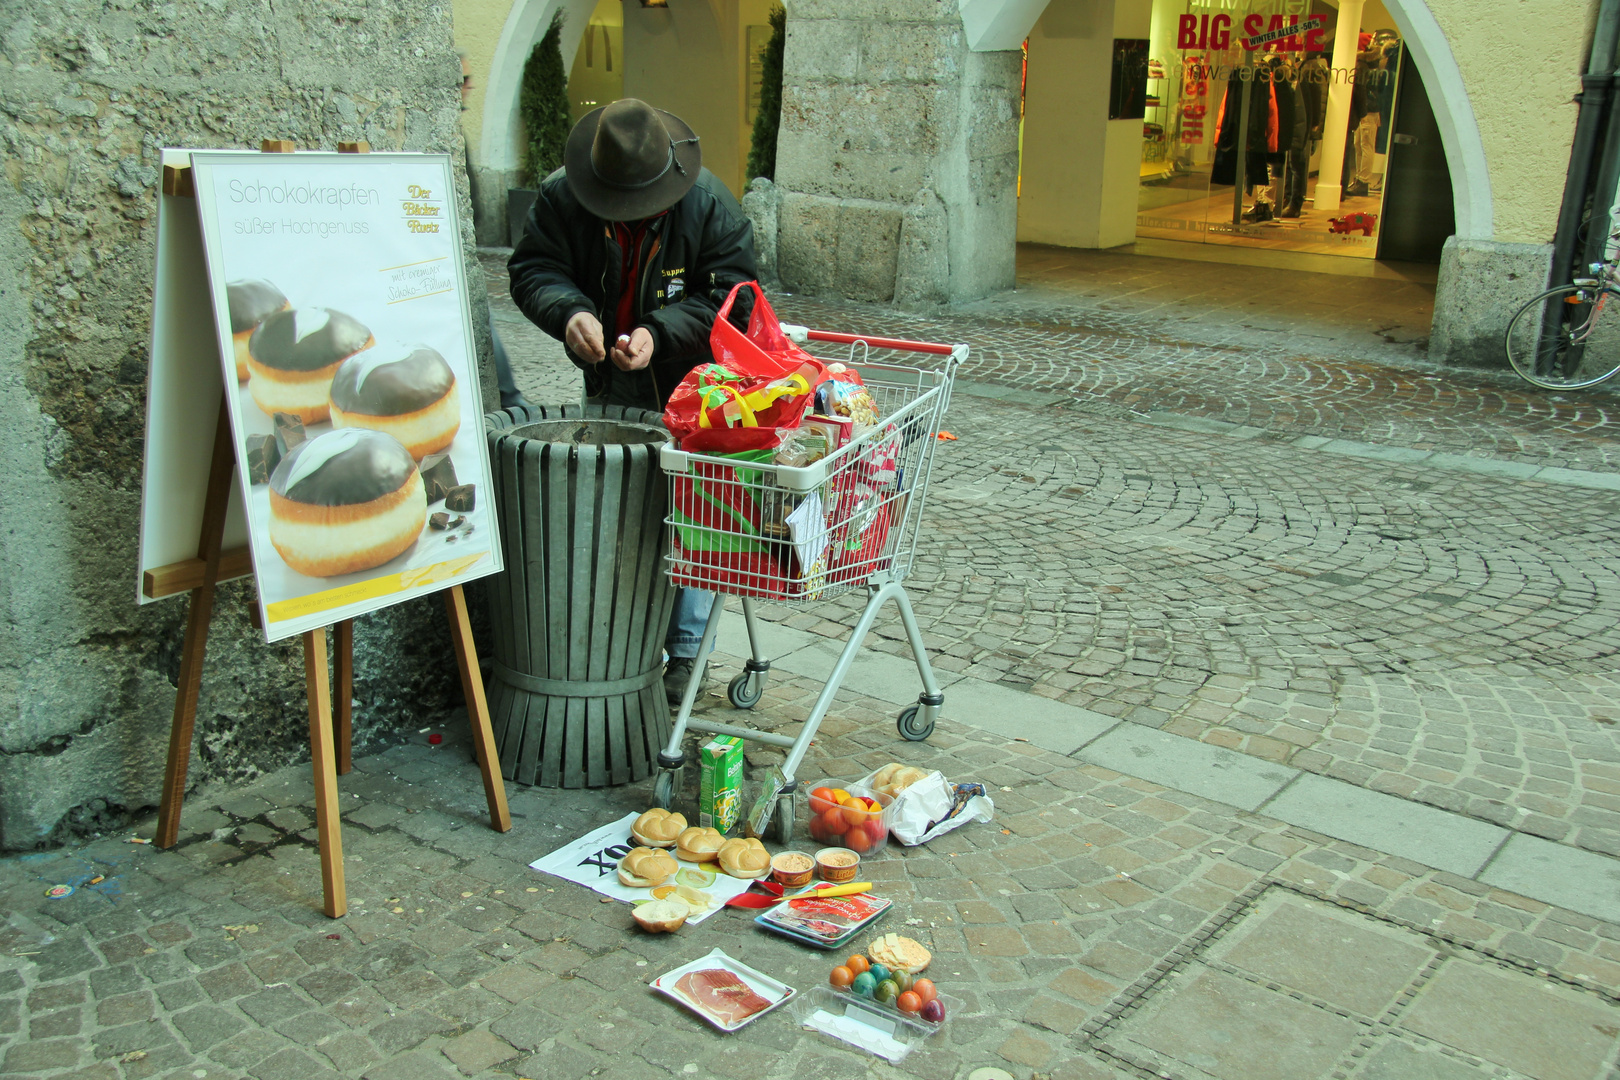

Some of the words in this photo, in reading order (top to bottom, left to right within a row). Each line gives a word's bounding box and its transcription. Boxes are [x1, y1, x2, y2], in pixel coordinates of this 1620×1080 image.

[1177, 13, 1231, 51] BIG
[1242, 14, 1328, 52] SALE
[1249, 31, 1277, 46] WINTER
[1277, 24, 1299, 39] ALLES
[1300, 19, 1320, 32] -50%
[229, 179, 380, 211] Schokokrapfen
[407, 184, 432, 199] Der
[402, 201, 440, 216] Bäcker
[234, 217, 277, 234] süßer
[281, 217, 370, 239] Hochgenuss
[407, 219, 440, 234] Ruetz
